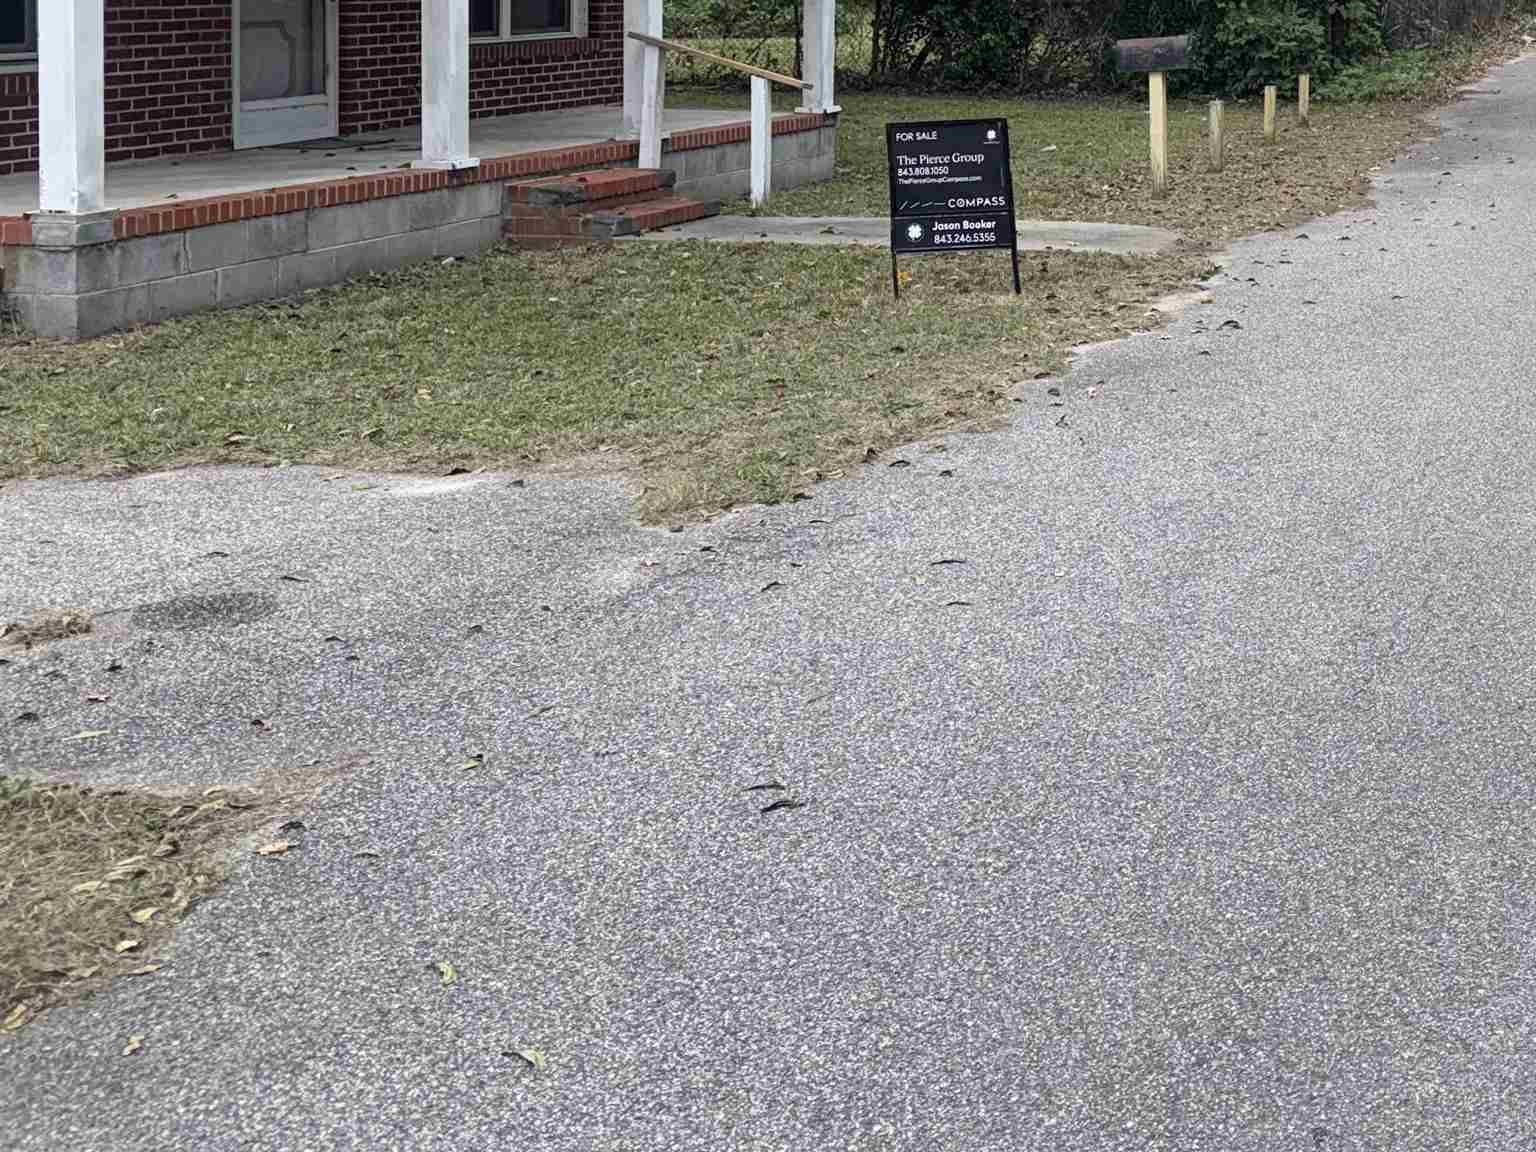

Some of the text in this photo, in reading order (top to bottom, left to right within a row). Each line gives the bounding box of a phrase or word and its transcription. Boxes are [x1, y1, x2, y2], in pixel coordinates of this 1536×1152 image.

[896, 131, 937, 142] FOR SALE
[896, 152, 985, 166] The Pierce Group
[947, 196, 1006, 208] COMPASS
[932, 219, 996, 231] Jason Booker
[934, 232, 996, 244] 843.246.5355
